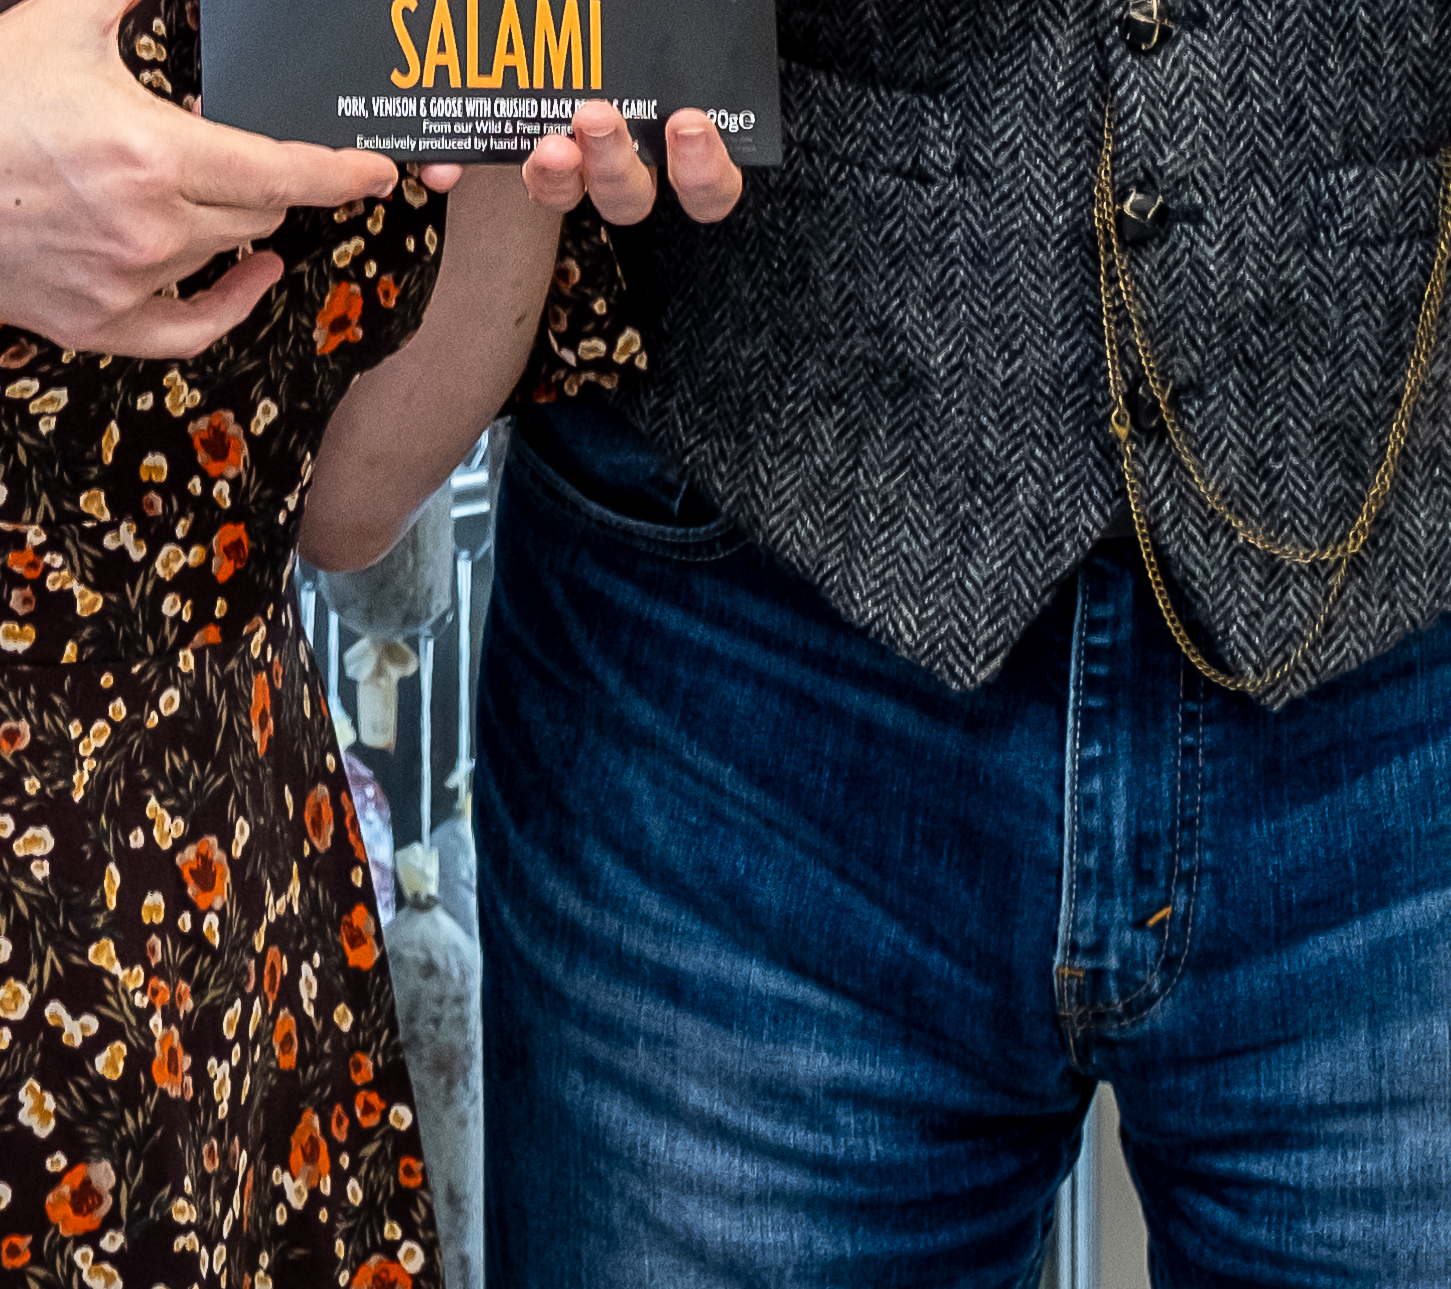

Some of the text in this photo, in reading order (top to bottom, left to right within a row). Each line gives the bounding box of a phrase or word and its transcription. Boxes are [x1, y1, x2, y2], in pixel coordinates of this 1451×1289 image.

[337, 95, 369, 119] PORK,
[372, 96, 417, 118] VENISON
[419, 96, 428, 118] &
[429, 97, 463, 119] GOOSE
[464, 97, 492, 119] WITH
[493, 97, 539, 119] CRUSHED
[540, 97, 573, 120] BLACK
[622, 98, 658, 121] GARLIC
[422, 119, 574, 136] From our Wild & Free range
[356, 133, 416, 152] Exclusively
[418, 134, 472, 151] produced
[474, 135, 487, 152] by
[490, 135, 518, 151] hand
[520, 135, 531, 151] in
